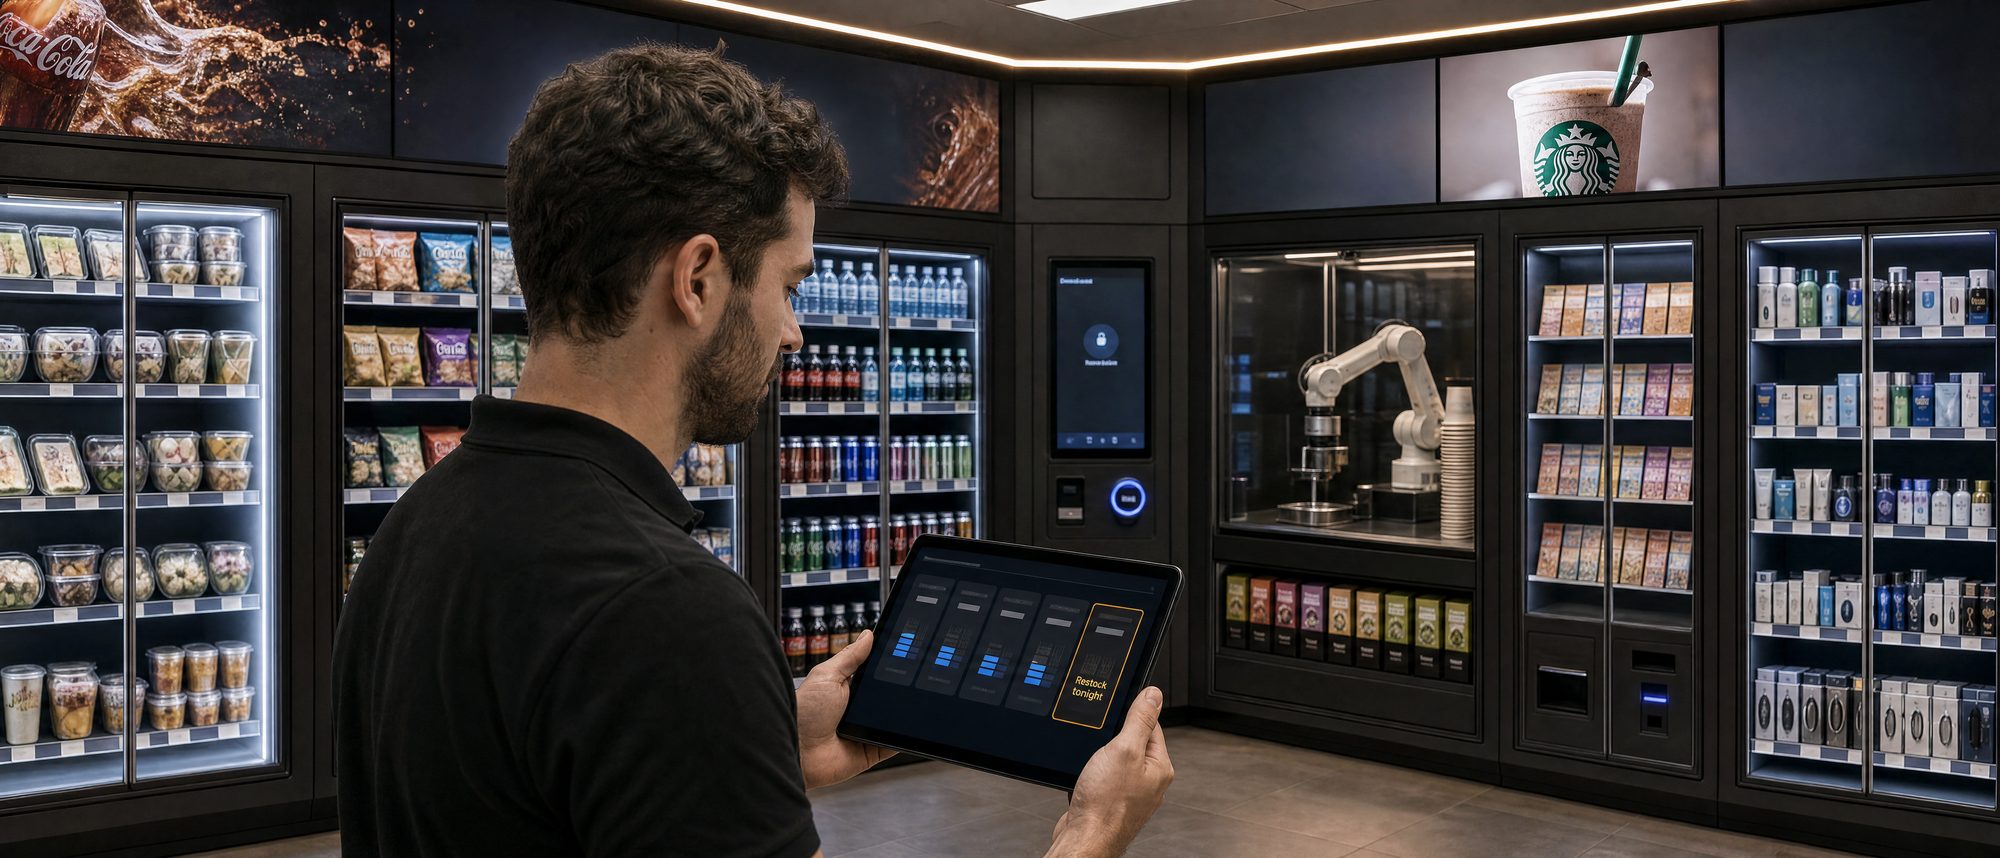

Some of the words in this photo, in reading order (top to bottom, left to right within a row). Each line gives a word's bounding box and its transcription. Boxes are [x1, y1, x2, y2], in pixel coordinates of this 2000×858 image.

[0, 12, 97, 80] oca-Cola
[1075, 675, 1107, 689] Restock
[1072, 687, 1103, 701] tonight
